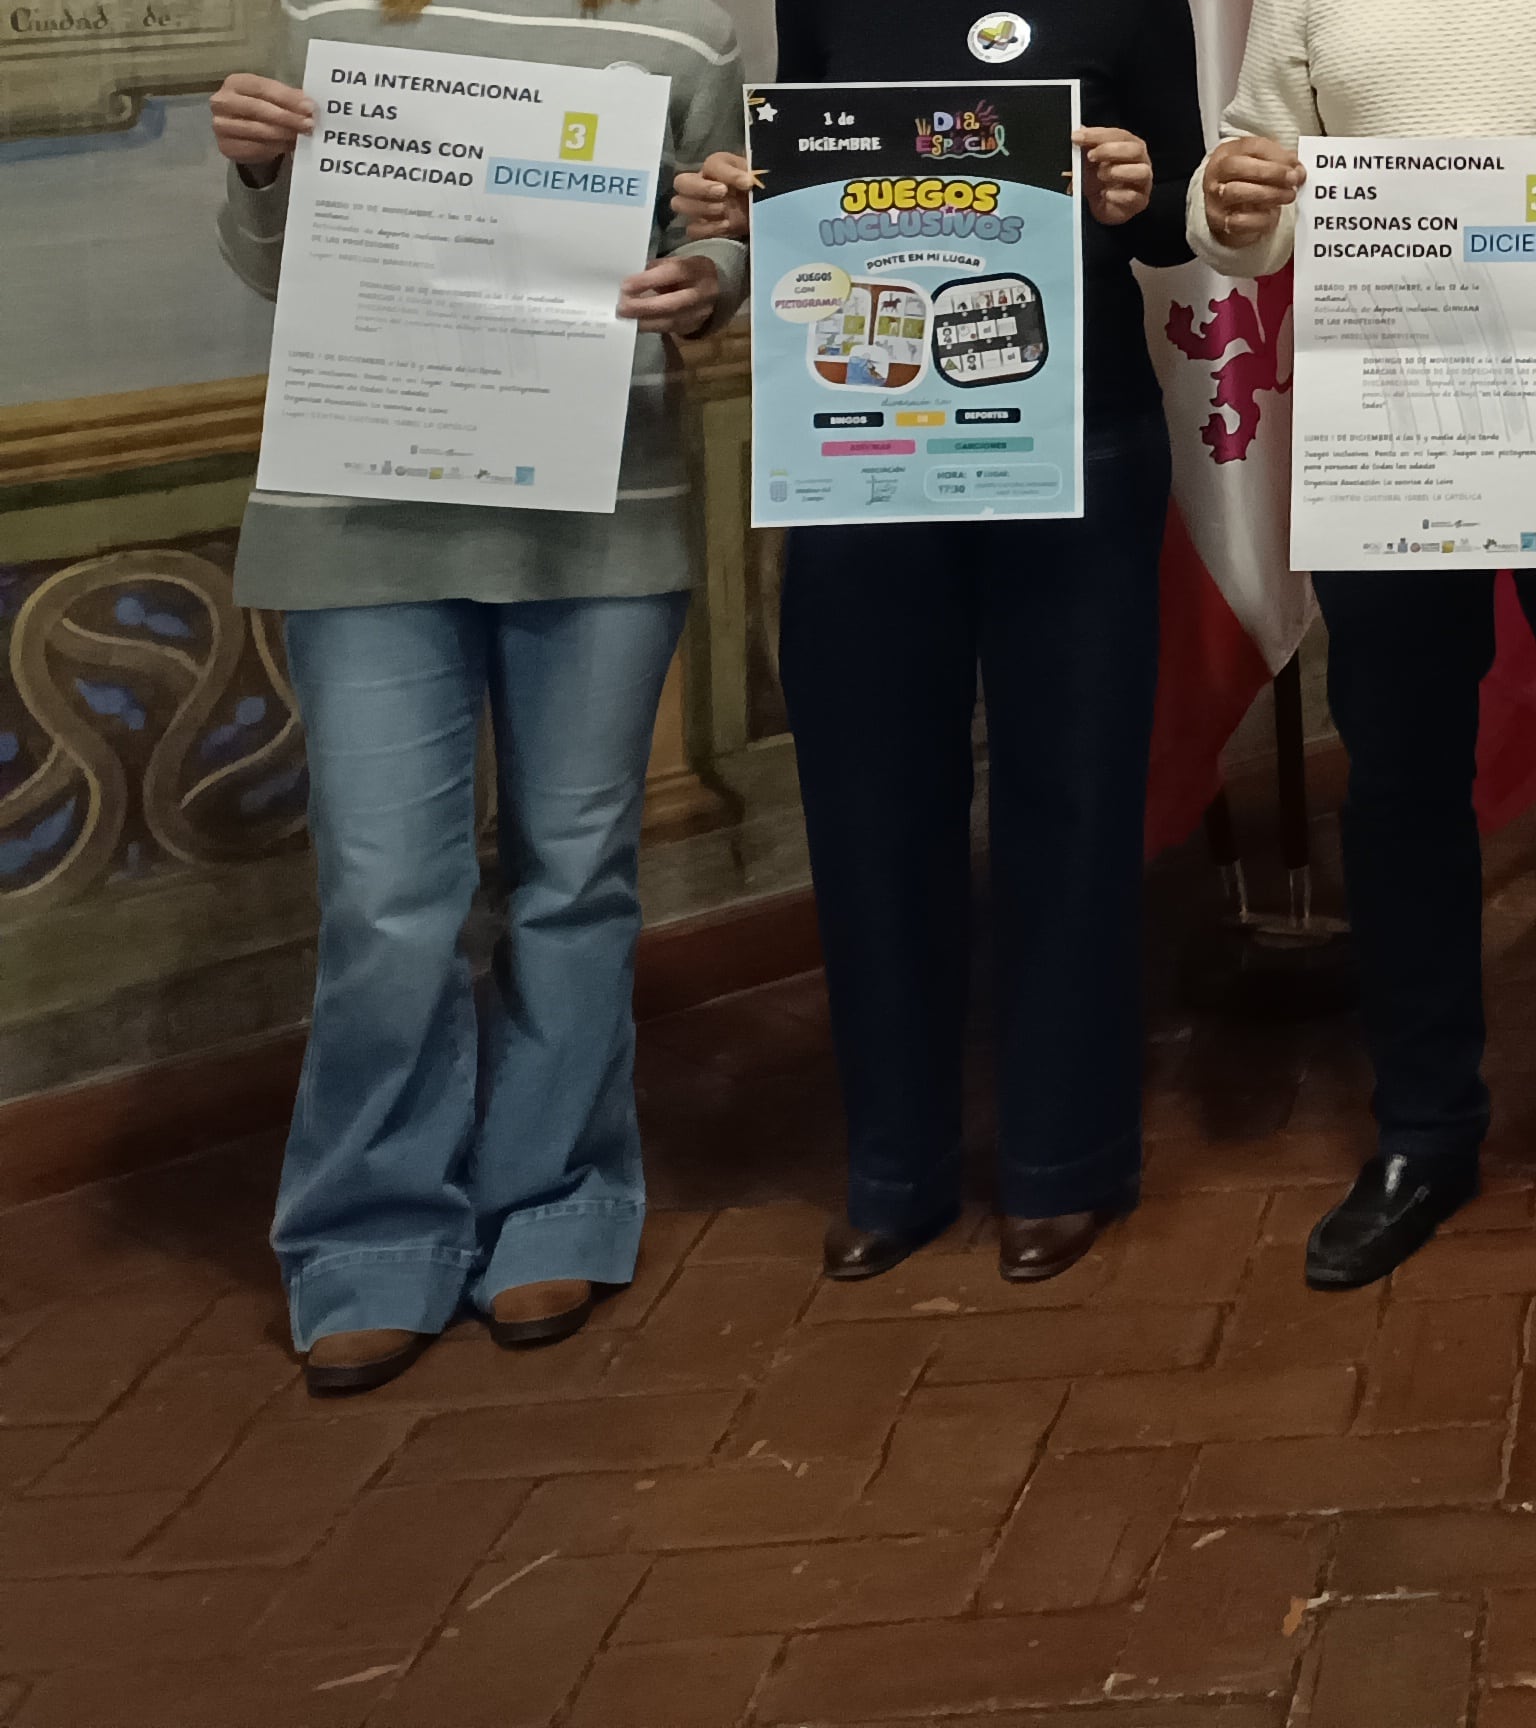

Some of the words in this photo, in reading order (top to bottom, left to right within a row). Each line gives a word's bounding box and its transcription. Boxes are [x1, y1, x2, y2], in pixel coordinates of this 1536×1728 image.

[330, 68, 367, 86] DIA
[374, 73, 542, 104] INTERNACIONAL
[327, 99, 353, 116] DE
[360, 103, 397, 120] LAS
[823, 111, 833, 125] 1
[837, 111, 855, 125] de
[323, 129, 432, 155] PERSONAS
[438, 141, 484, 160] CON
[566, 123, 586, 150] 3
[319, 157, 474, 187] DISCAPACIDAD
[1315, 154, 1347, 169] DIA
[1353, 155, 1505, 170] INTERNACIONAL
[494, 165, 640, 196] DICIEMBRE
[1314, 185, 1338, 200] DE
[1344, 185, 1377, 200] LAS
[841, 178, 1000, 213] JUEGOS
[818, 211, 1024, 247] INCLUSIVOS
[1314, 216, 1412, 231] PERSONAS
[1417, 216, 1458, 231] CON
[866, 254, 906, 270] PONTE
[908, 253, 924, 261] EN
[927, 253, 940, 261] MI
[942, 254, 981, 267] LUGAR
[1314, 243, 1452, 258] DISCAPACIDAD
